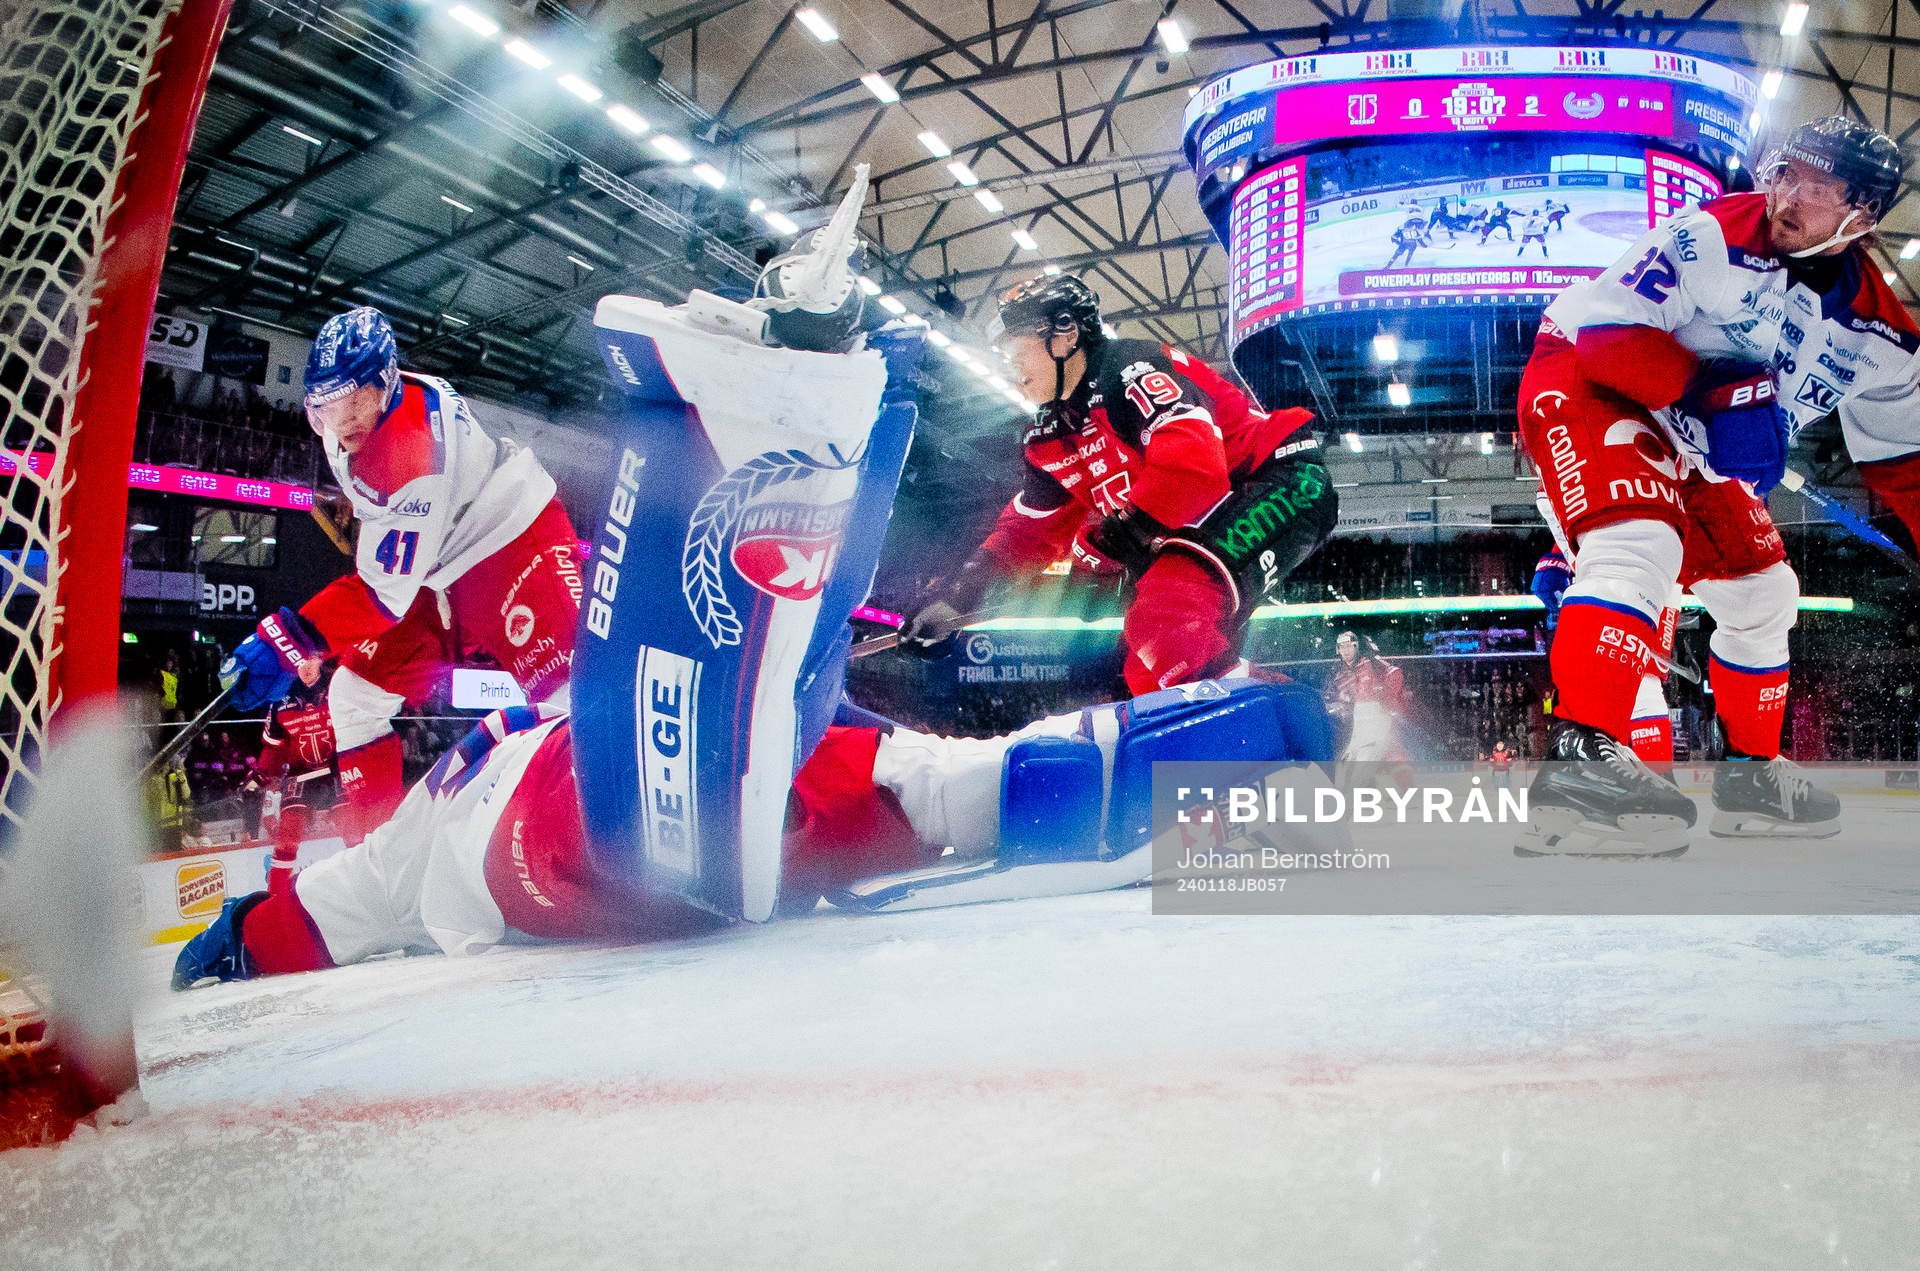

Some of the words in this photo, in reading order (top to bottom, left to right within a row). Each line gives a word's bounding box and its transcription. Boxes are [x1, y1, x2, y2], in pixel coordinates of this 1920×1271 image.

[1408, 98, 1422, 117] 0
[1525, 95, 1538, 115] 2
[1685, 99, 1746, 134] PRESENTE
[1364, 271, 1431, 288] POWERPLAY
[1432, 271, 1511, 286] PRESENTERAS
[1511, 271, 1527, 284] AV
[1618, 246, 1678, 305] 32
[1124, 371, 1184, 419] 19
[130, 467, 161, 484] enta
[180, 474, 217, 490] renta
[1546, 424, 1588, 521] coolcon
[236, 482, 271, 498] renta
[289, 490, 313, 505] ren
[376, 530, 421, 575] 41
[587, 447, 647, 641] BAUER
[1660, 608, 1677, 651] coolco
[1622, 634, 1652, 667] STE
[481, 682, 511, 698] Prinfo
[1631, 725, 1661, 740] STENA
[512, 820, 555, 908] BAUER
